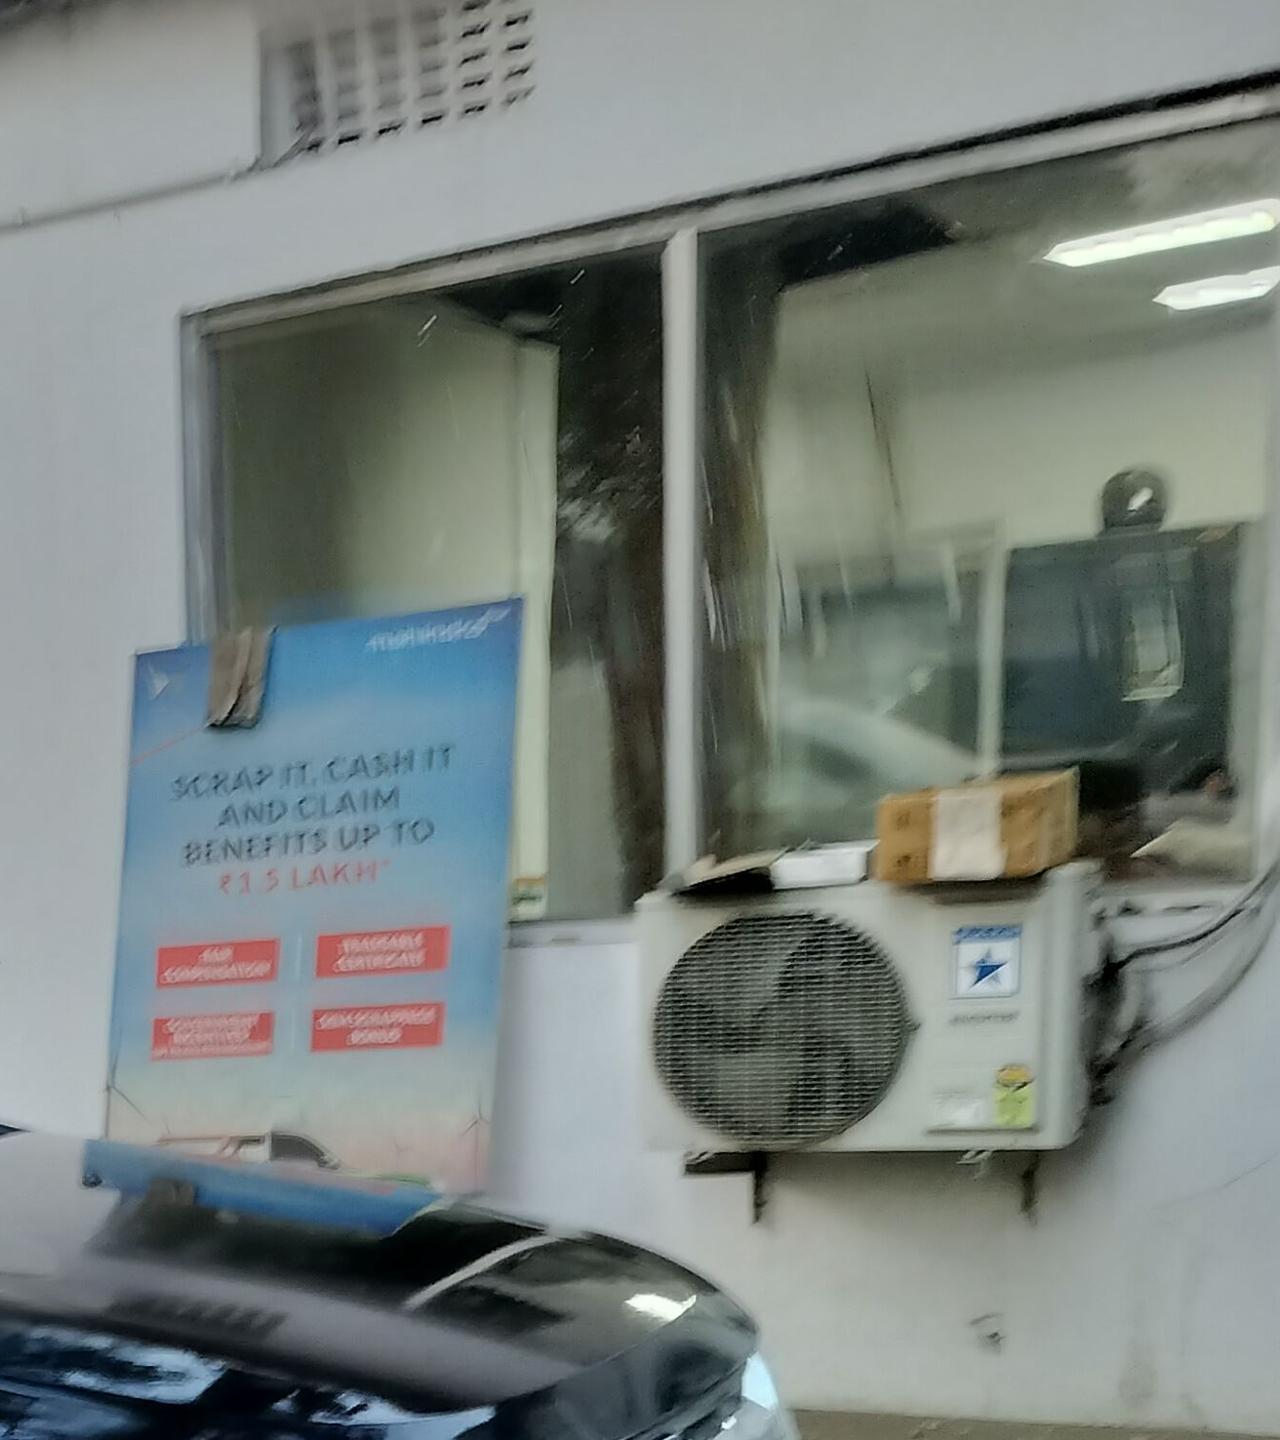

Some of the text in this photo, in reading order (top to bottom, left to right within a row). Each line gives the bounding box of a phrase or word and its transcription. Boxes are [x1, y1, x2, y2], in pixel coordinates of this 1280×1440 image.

[172, 764, 273, 800] SCRAP
[324, 748, 415, 783] CASH
[425, 743, 455, 772] IT
[217, 786, 400, 828] AND CLAIM
[183, 817, 435, 867] BENEFITS UP TO
